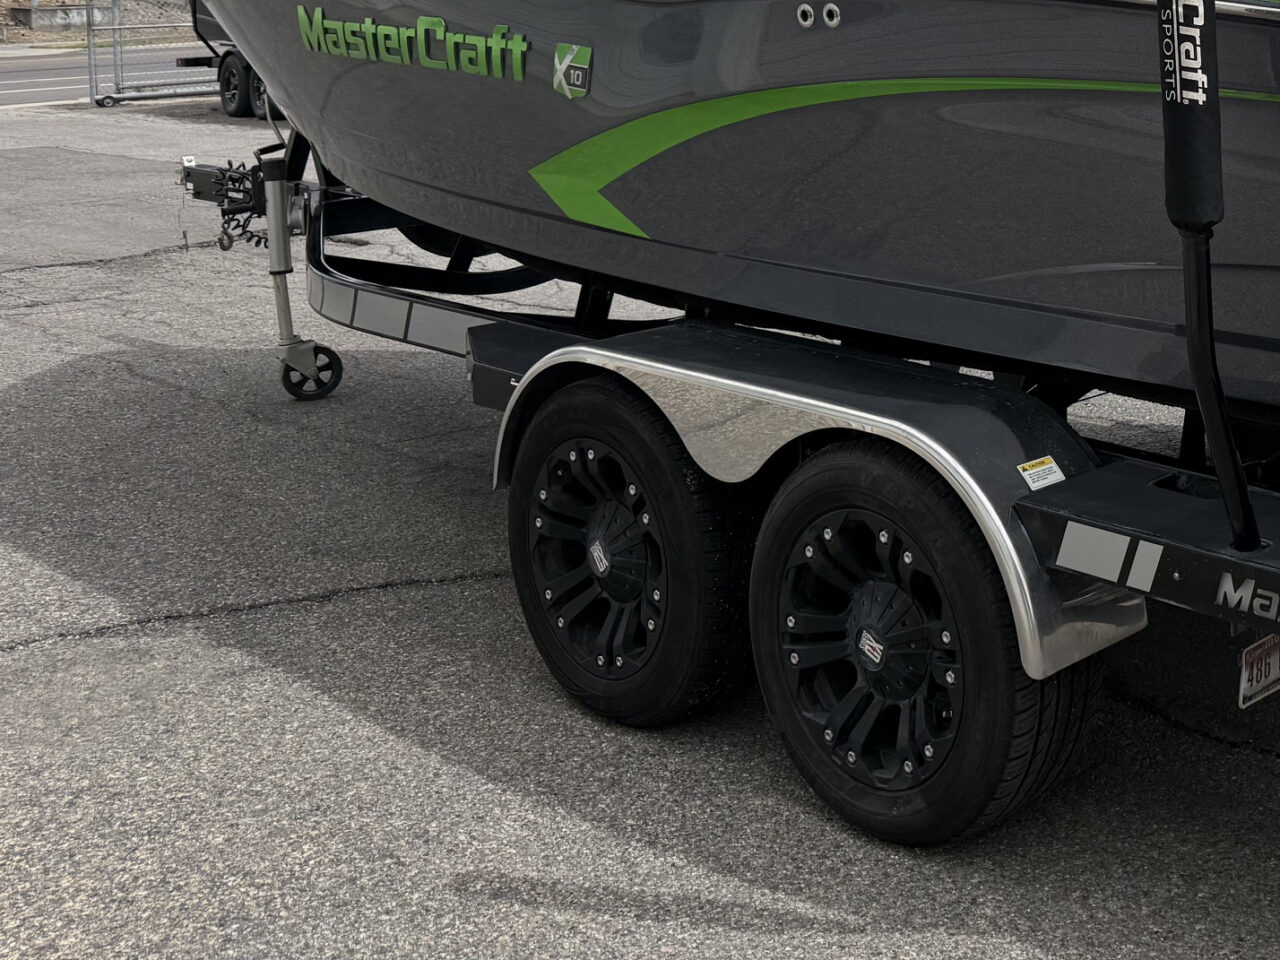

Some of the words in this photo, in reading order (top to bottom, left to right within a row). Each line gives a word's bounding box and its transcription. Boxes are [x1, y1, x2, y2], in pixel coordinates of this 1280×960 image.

[297, 4, 528, 82] MasterCraft
[1161, 9, 1176, 102] SPORTS
[569, 69, 583, 86] 10
[1247, 652, 1272, 688] 486
